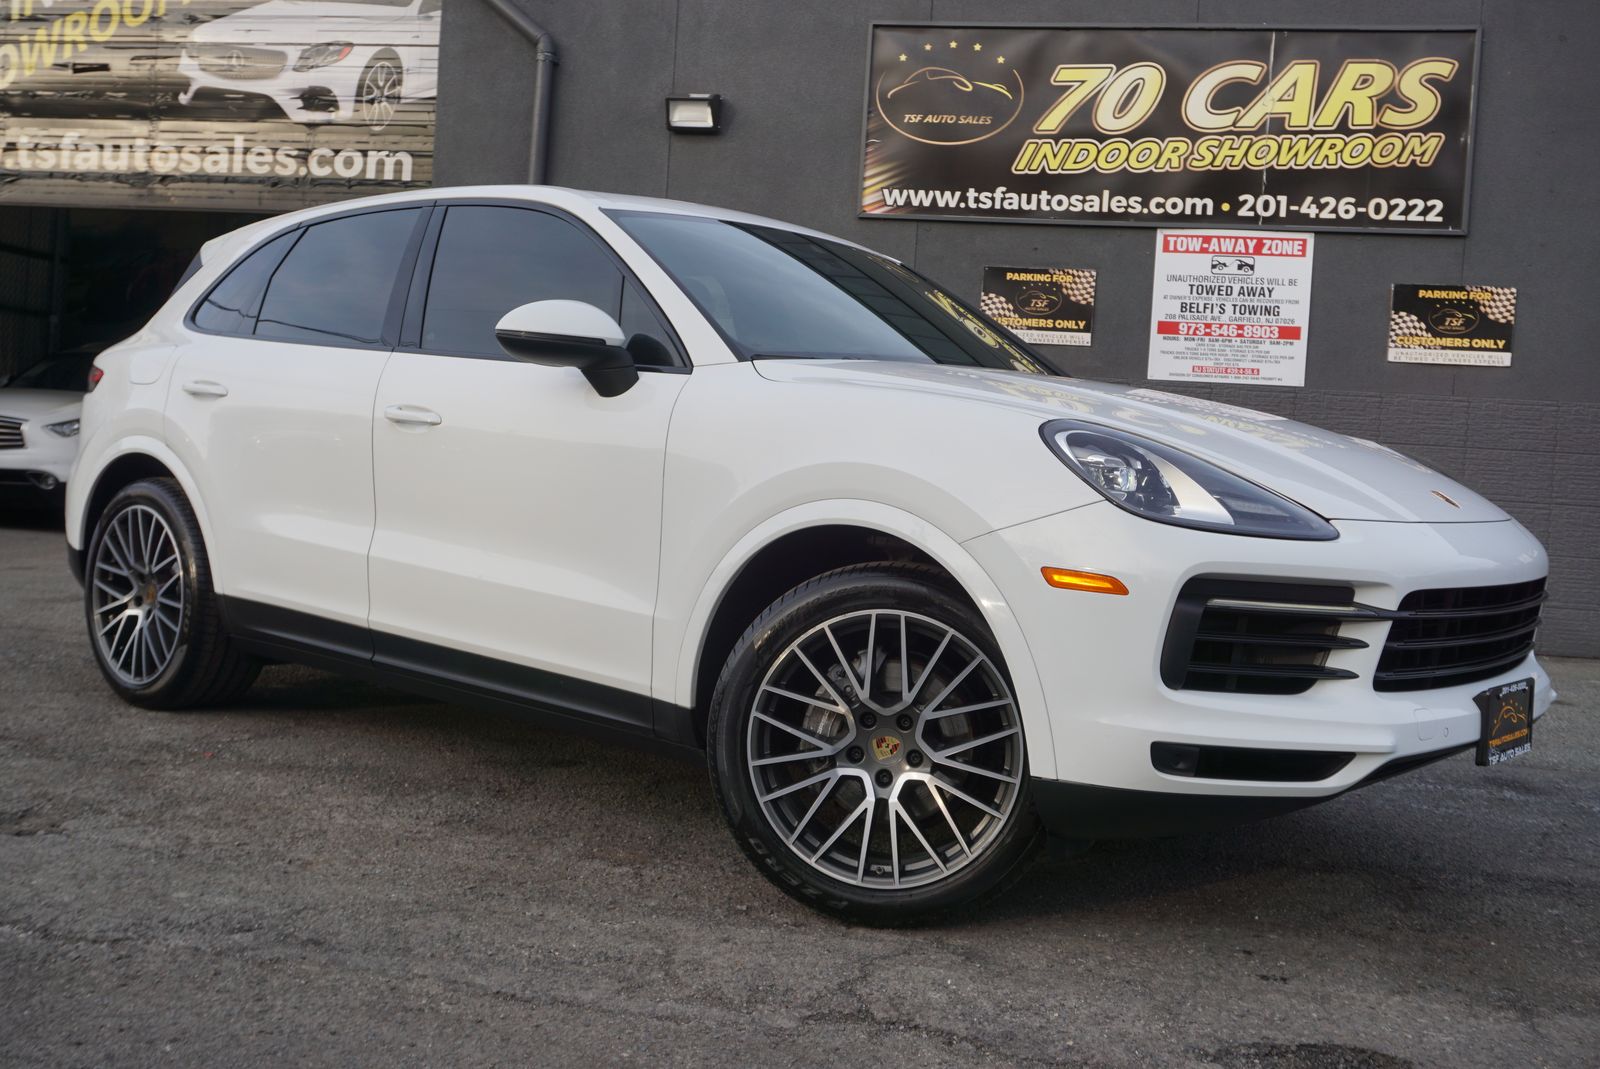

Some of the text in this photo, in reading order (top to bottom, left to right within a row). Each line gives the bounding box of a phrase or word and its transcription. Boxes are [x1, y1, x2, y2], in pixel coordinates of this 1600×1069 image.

[1033, 57, 1459, 135] 70 CARS
[903, 114, 993, 125] TSF AUTO SALES
[1011, 132, 1446, 174] INDOOR SHOWROOM
[882, 186, 1444, 222] www.tsfautosales.com 201-426-0222
[1167, 237, 1303, 256] TOW-AWAY ZONE
[1006, 272, 1073, 283] PARKING FOR
[1166, 274, 1299, 287] UNAUTHORIZED VEHICLES WILL BE
[1188, 284, 1275, 298] TOWED AWAY
[1418, 289, 1492, 301] PARKING FOR
[1030, 299, 1049, 307] TSF
[1180, 301, 1281, 317] BELFI'S TOWING
[993, 317, 1086, 330] USTOMERS ONLY
[1444, 317, 1466, 326] TSF
[1178, 322, 1280, 339] 973-546-8903
[1396, 336, 1506, 349] CUSTOMERS ONLY
